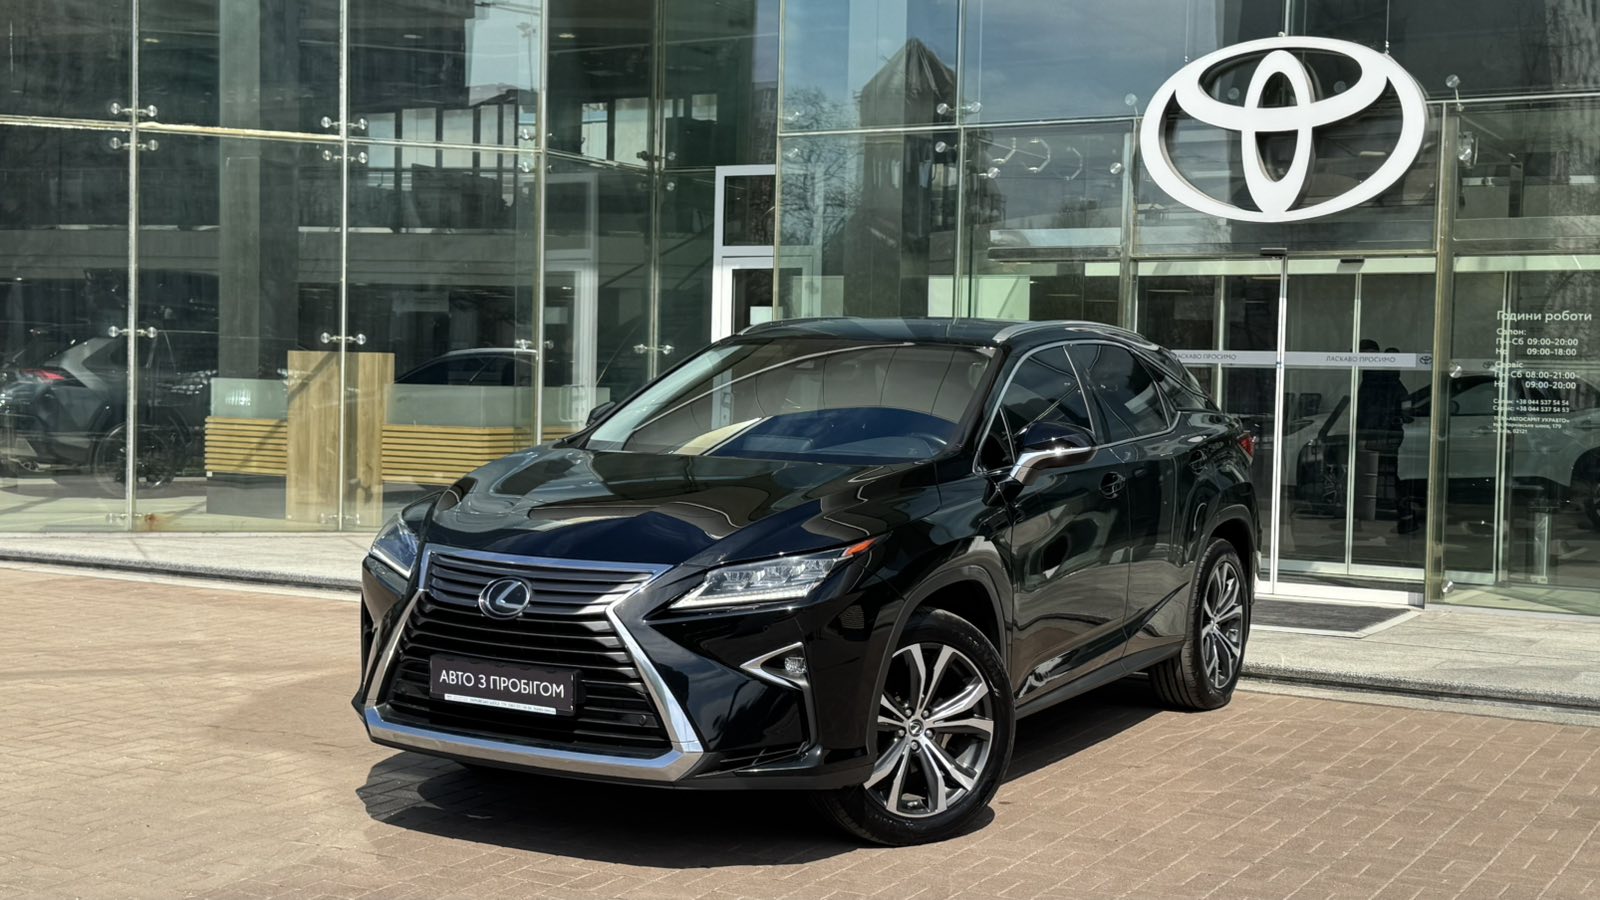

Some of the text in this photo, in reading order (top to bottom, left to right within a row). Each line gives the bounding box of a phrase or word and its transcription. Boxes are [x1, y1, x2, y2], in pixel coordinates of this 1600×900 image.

[1545, 310, 1592, 323] роботи
[440, 669, 564, 698] АВТО З ПРОБІГОМ
